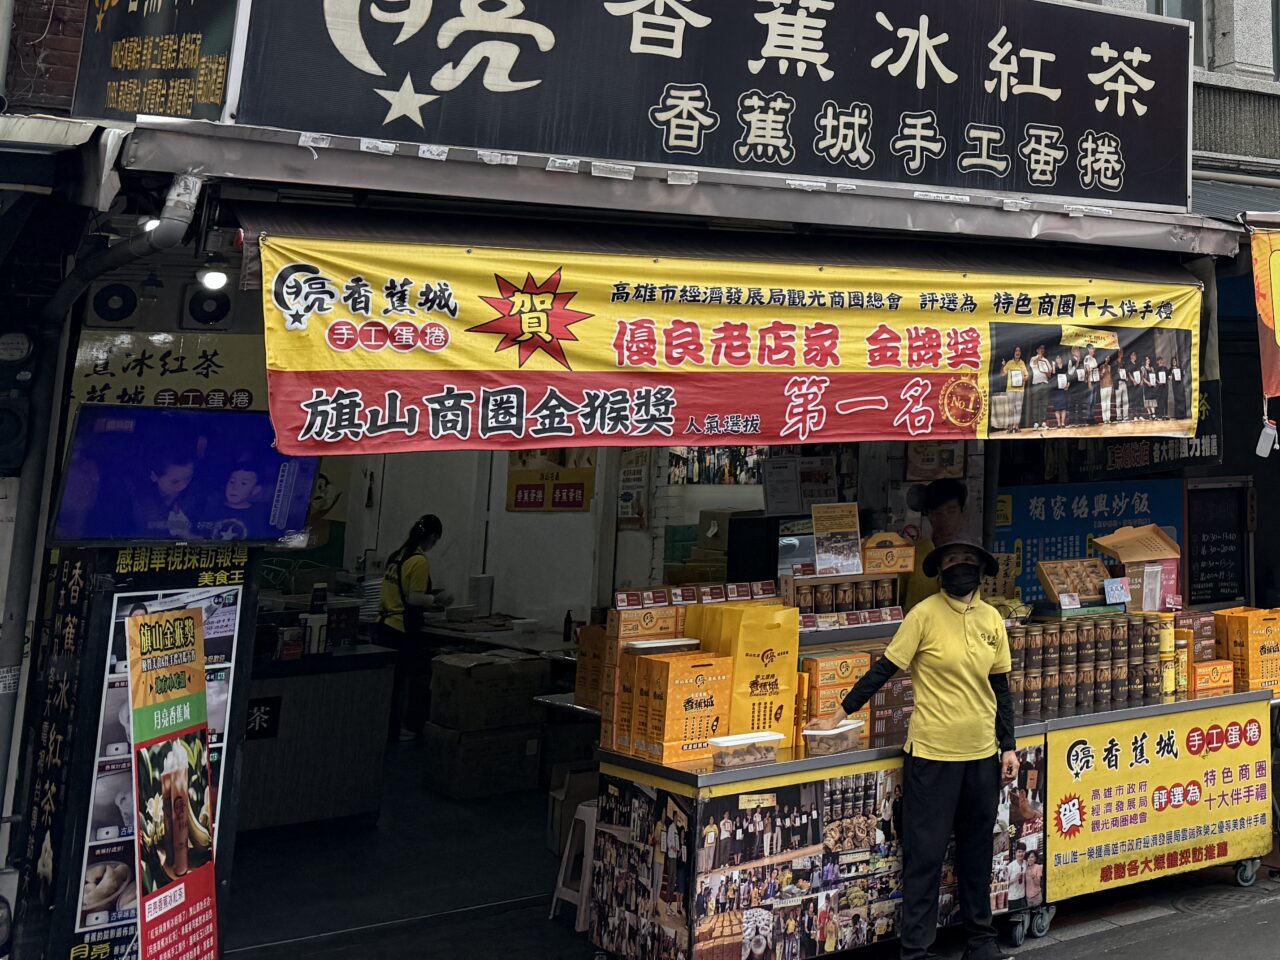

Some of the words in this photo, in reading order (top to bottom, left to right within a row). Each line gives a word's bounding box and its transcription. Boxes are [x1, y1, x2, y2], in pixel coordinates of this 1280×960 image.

[649, 83, 1127, 192] 香蕉城手工蛋捲
[342, 277, 459, 318] 香蕉城
[610, 282, 904, 312] 高雄市經濟發展局觀光商圈總會
[919, 291, 978, 314] 評選為
[993, 291, 1174, 321] 特色商圈十大伴手禮
[509, 291, 556, 343] 賀
[331, 324, 447, 349] 手工蛋捲
[613, 318, 841, 368] 優良老店家
[864, 323, 982, 370] 金牌獎
[156, 390, 251, 408] 手工蛋捲
[298, 385, 676, 443] 旗山商圈金猴獎
[682, 414, 761, 435] 人氣選拔
[780, 375, 936, 441] 第一名
[1028, 491, 1152, 522] 獨家紹興炒飯
[116, 546, 249, 574] 感謝華視採訪報導
[198, 569, 245, 586] 美食王
[748, 679, 780, 693] 香蕉城
[153, 702, 190, 730] 月亮香蕉城
[247, 705, 271, 731] 茶
[683, 695, 715, 713] 香蕉城
[1102, 729, 1179, 770] 香蕉城
[1187, 722, 1260, 752] 手工蛋捲
[1203, 760, 1267, 788] 特色商圈
[1091, 781, 1148, 801] 高雄市政府
[1152, 785, 1202, 811] 評選為
[1203, 783, 1267, 811] 十大伴手禮
[1060, 798, 1082, 833] 賀
[1091, 796, 1148, 816] 經濟發展局
[1091, 812, 1148, 833] 觀光商圈總會
